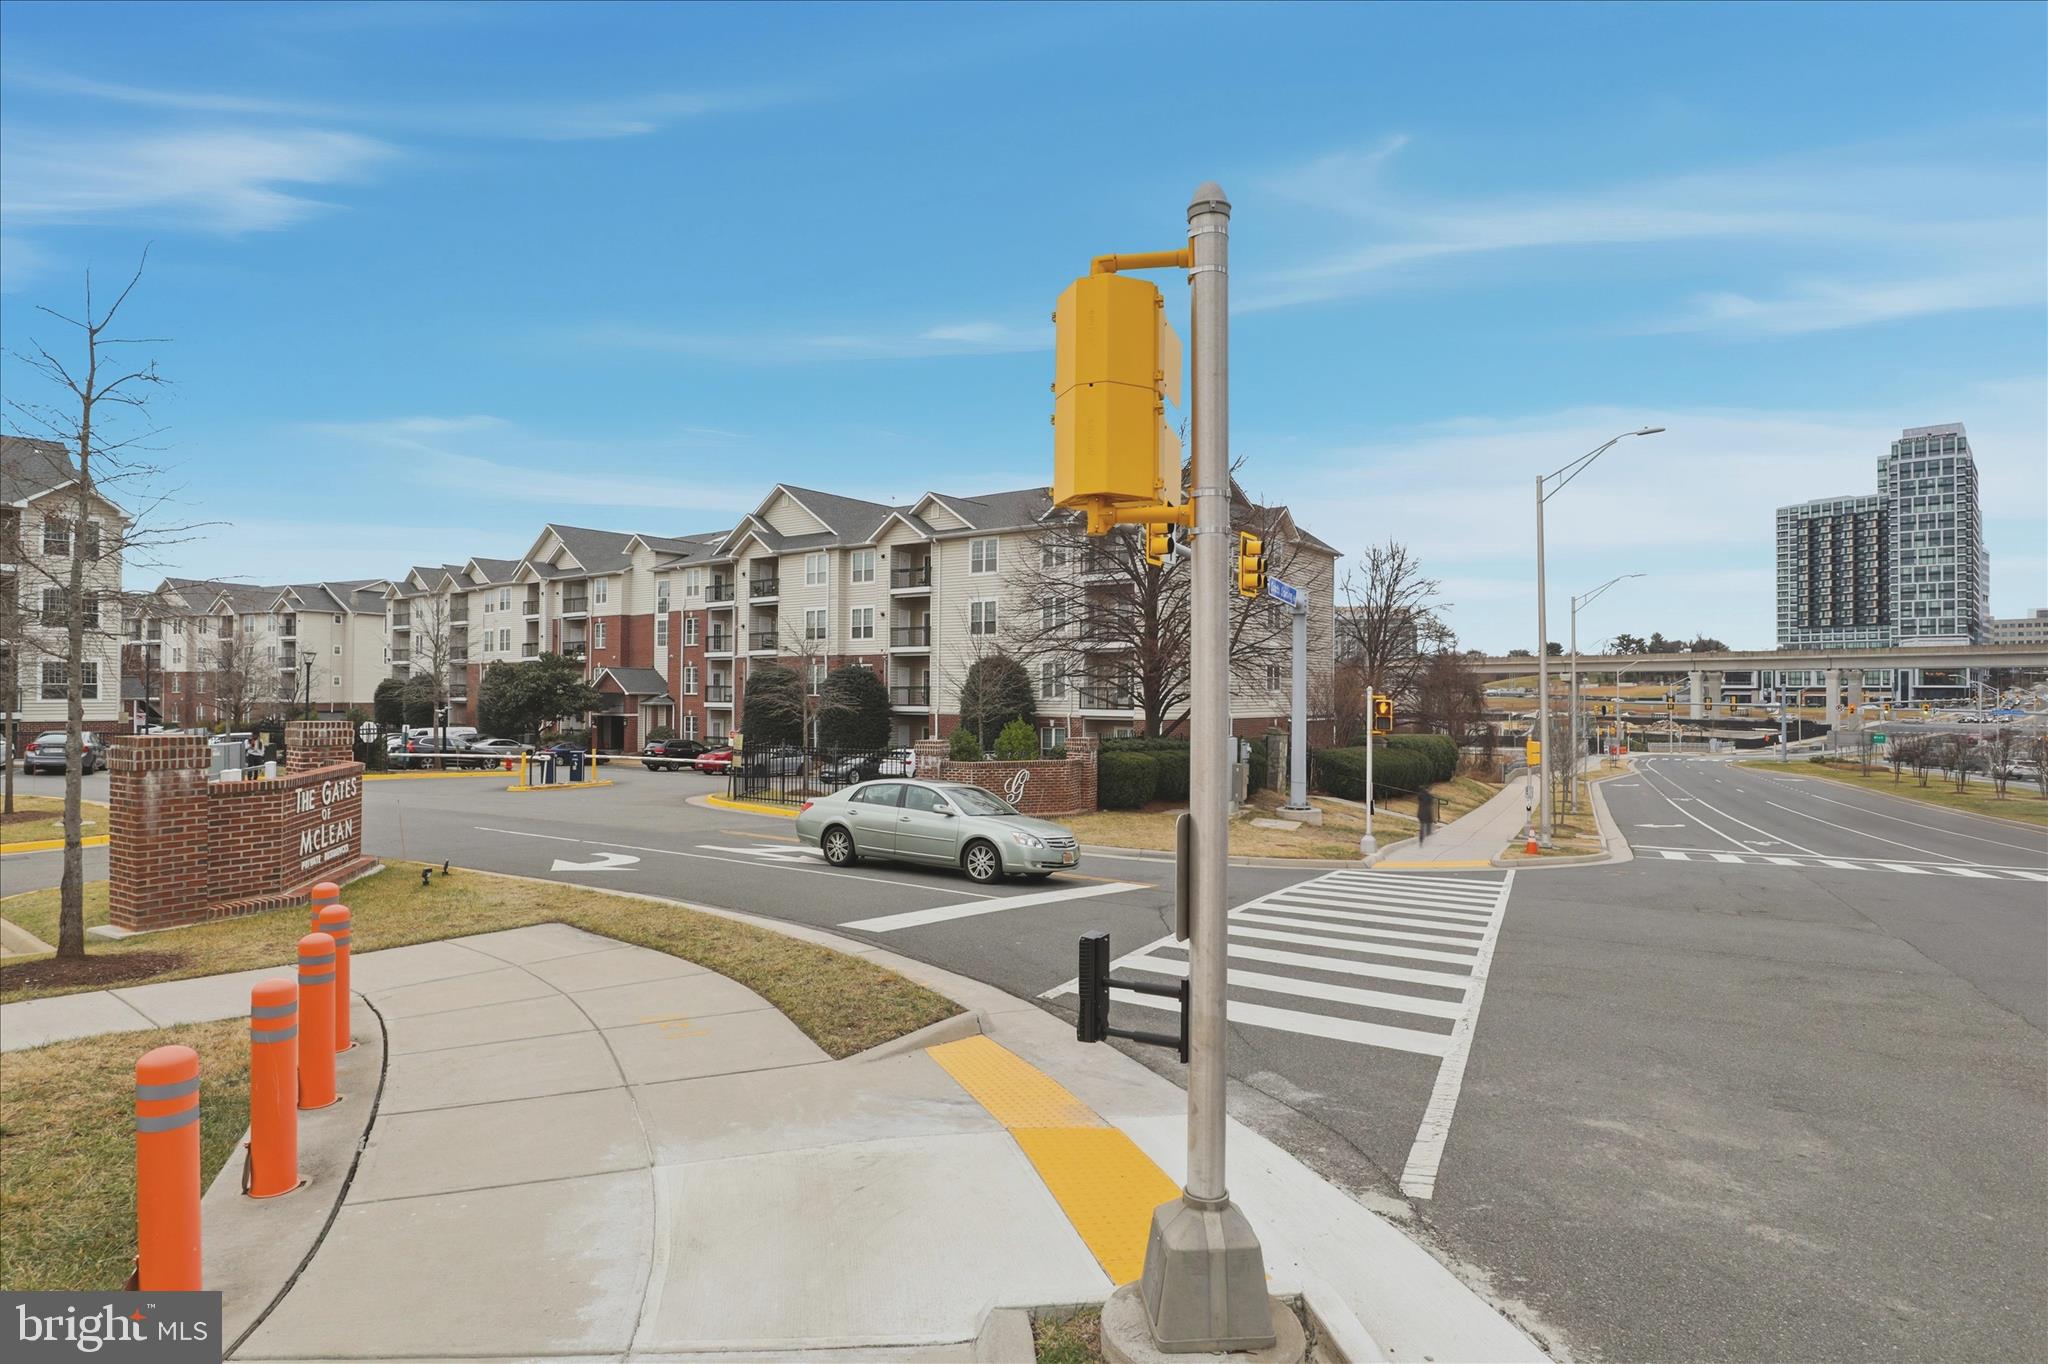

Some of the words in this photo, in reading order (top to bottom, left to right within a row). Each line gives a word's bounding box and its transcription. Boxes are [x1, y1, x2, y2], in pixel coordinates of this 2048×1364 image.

[295, 788, 315, 813] THE
[322, 777, 357, 805] GATES
[322, 808, 332, 820] OF
